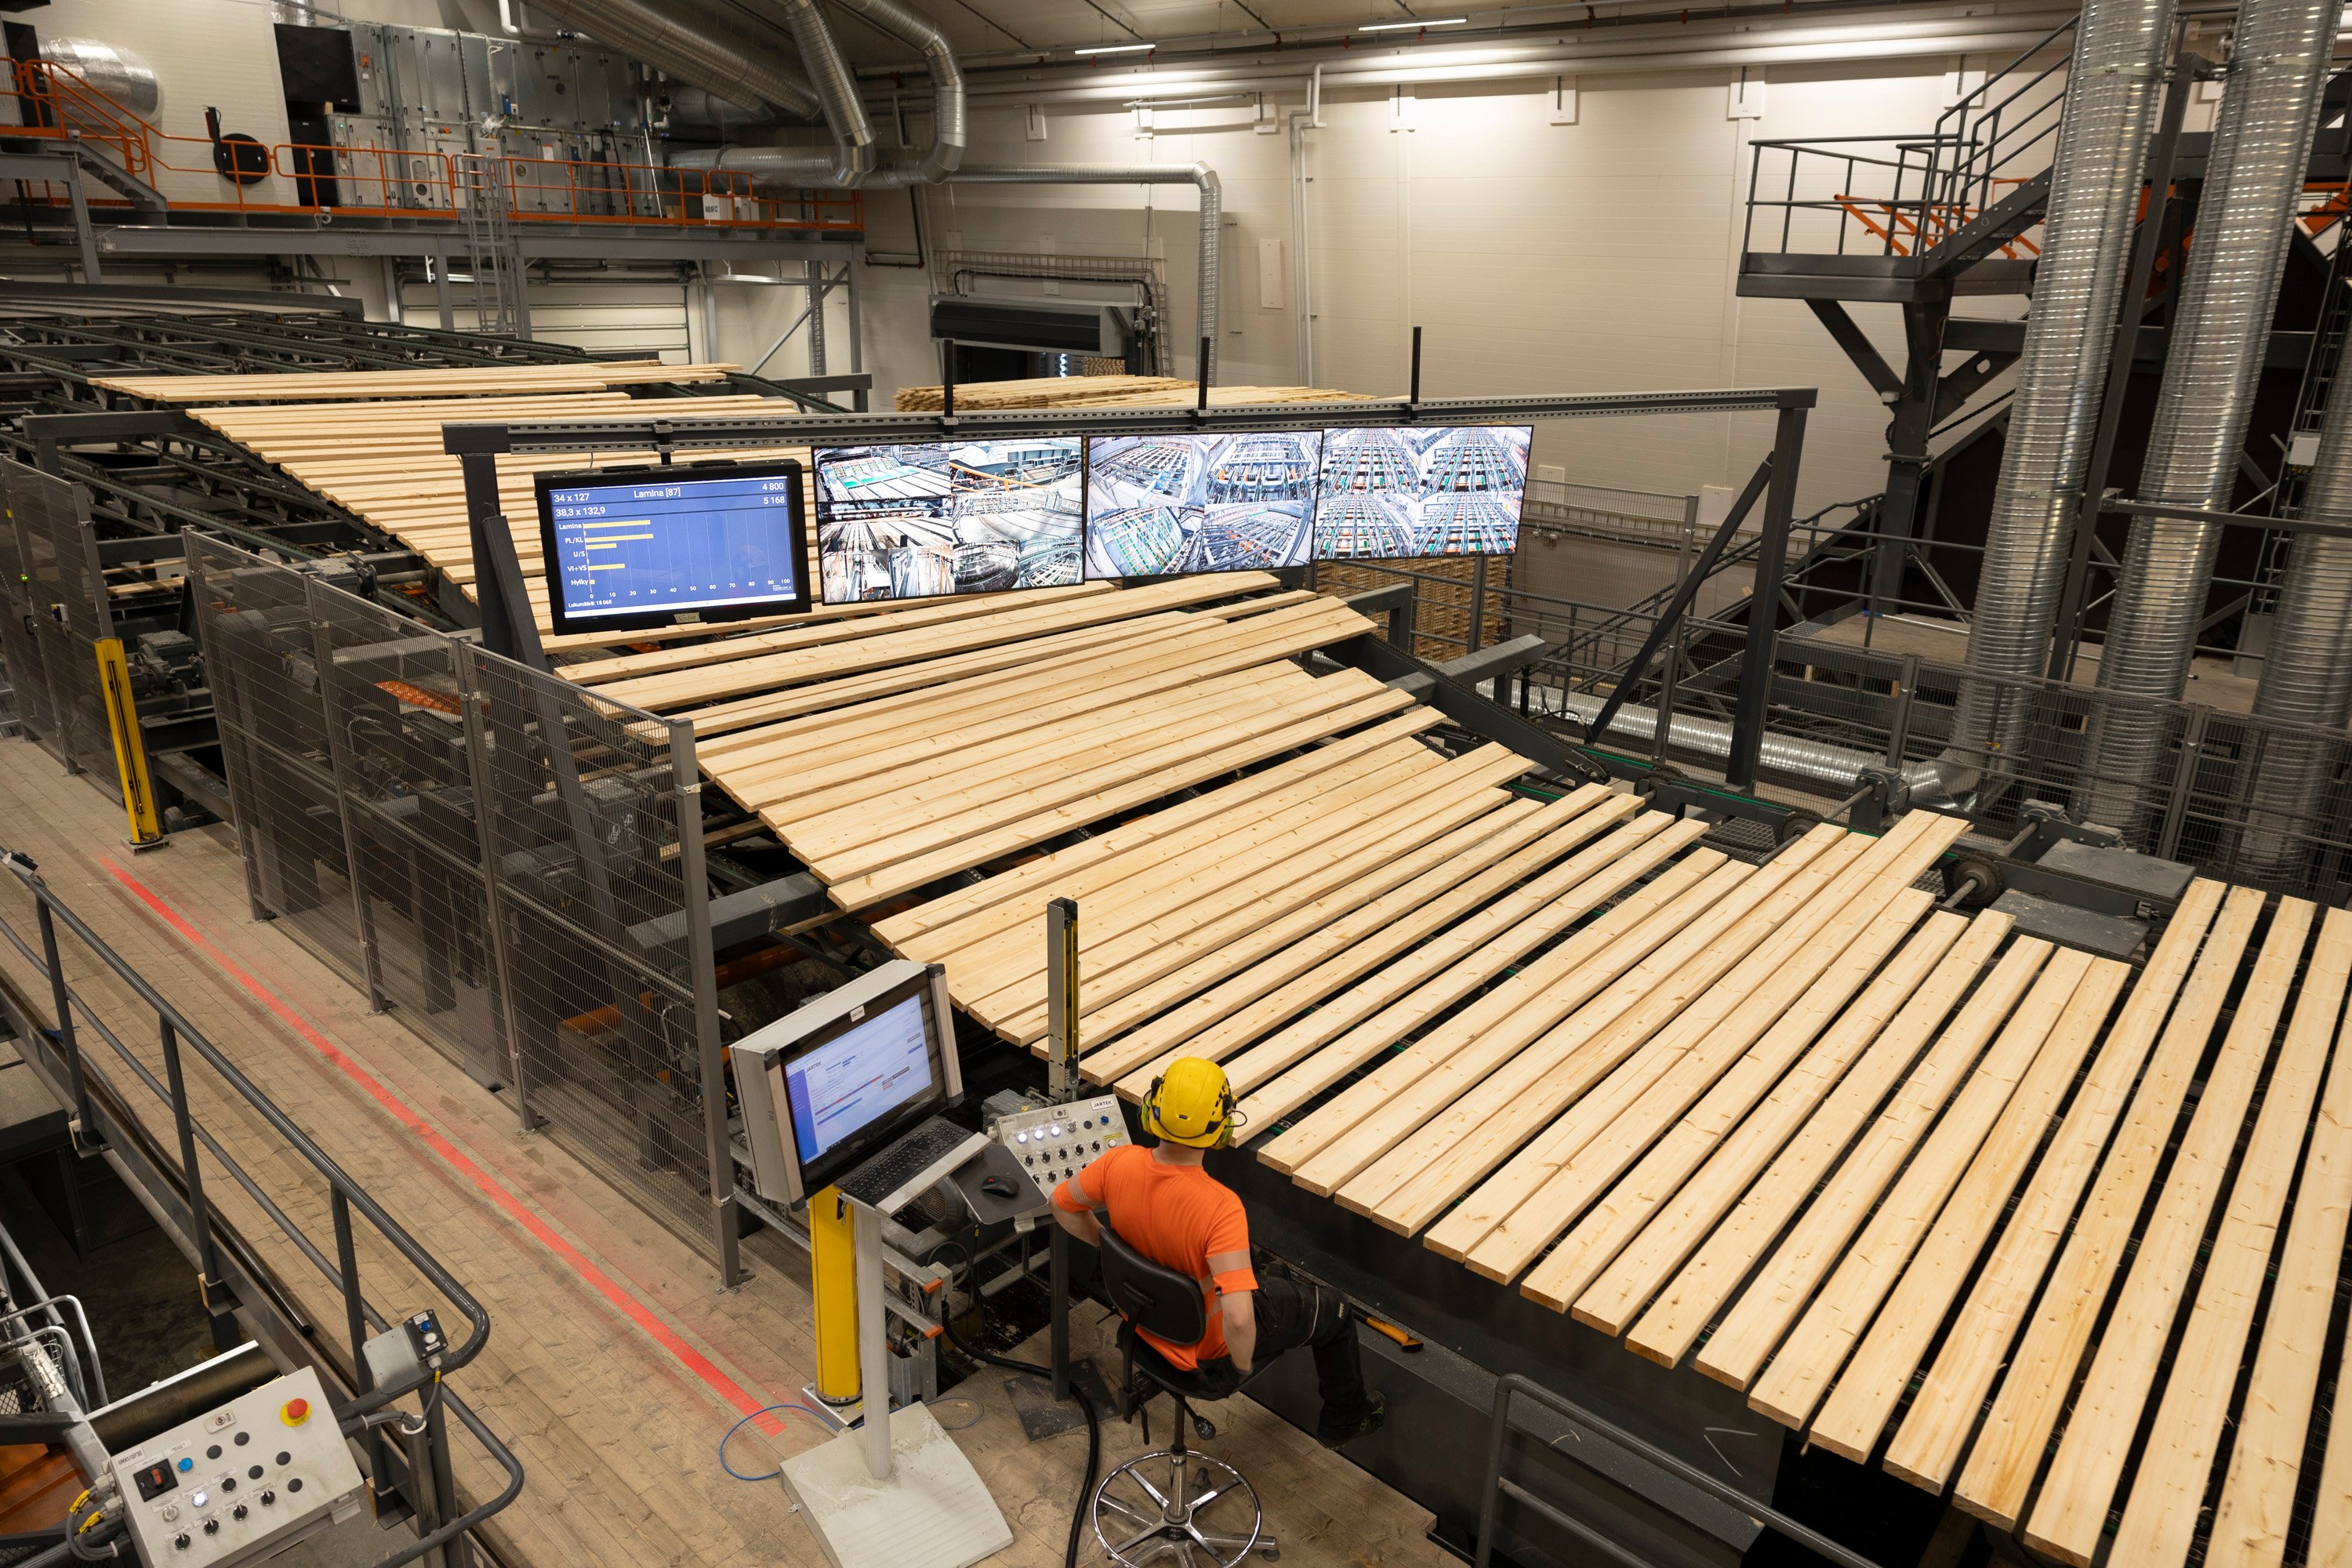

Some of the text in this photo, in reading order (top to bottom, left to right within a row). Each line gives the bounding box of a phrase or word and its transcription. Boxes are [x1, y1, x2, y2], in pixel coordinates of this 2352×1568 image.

[633, 487, 681, 499] Lamina [87]
[556, 509, 574, 517] 38,3
[583, 506, 606, 516] 132,9
